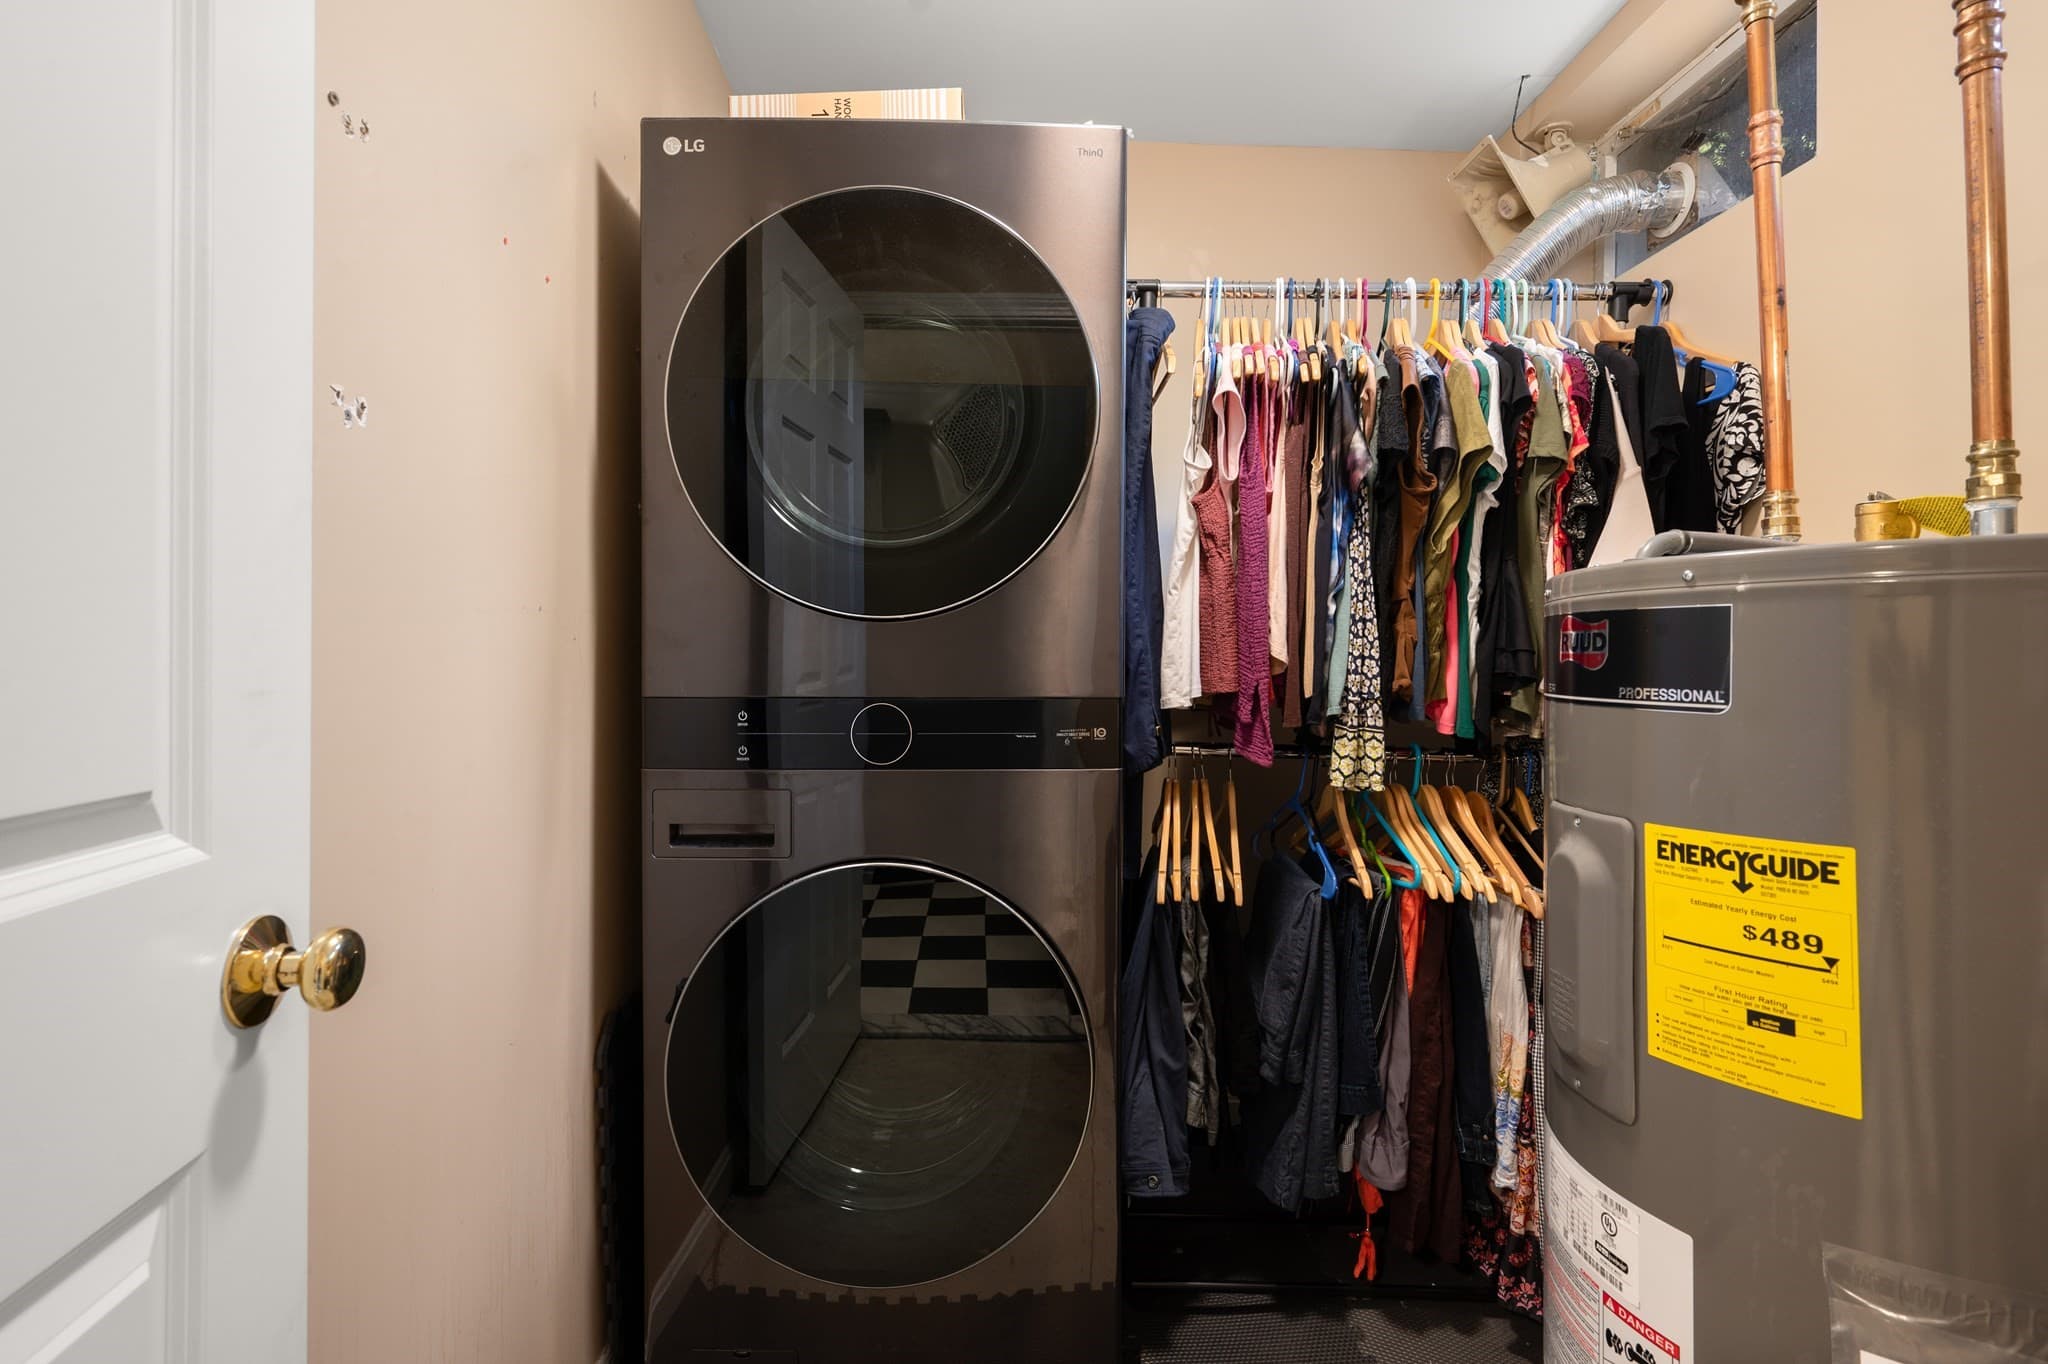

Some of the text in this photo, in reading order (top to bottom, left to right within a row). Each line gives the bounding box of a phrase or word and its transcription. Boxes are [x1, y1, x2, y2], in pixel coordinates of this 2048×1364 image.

[684, 139, 705, 152] LG
[1075, 147, 1104, 158] ThinQ
[1561, 631, 1607, 653] RUUD
[1618, 686, 1725, 704] PROFESSIONAL
[1657, 839, 1840, 886] ENERGYGUIDE
[1690, 898, 1797, 923] Estimated Yearly Energy Cost
[1742, 924, 1824, 955] $489
[1714, 985, 1732, 996] First
[1735, 990, 1756, 1001] Hour
[1758, 996, 1788, 1009] Rating
[1618, 1306, 1676, 1355] DANGER
